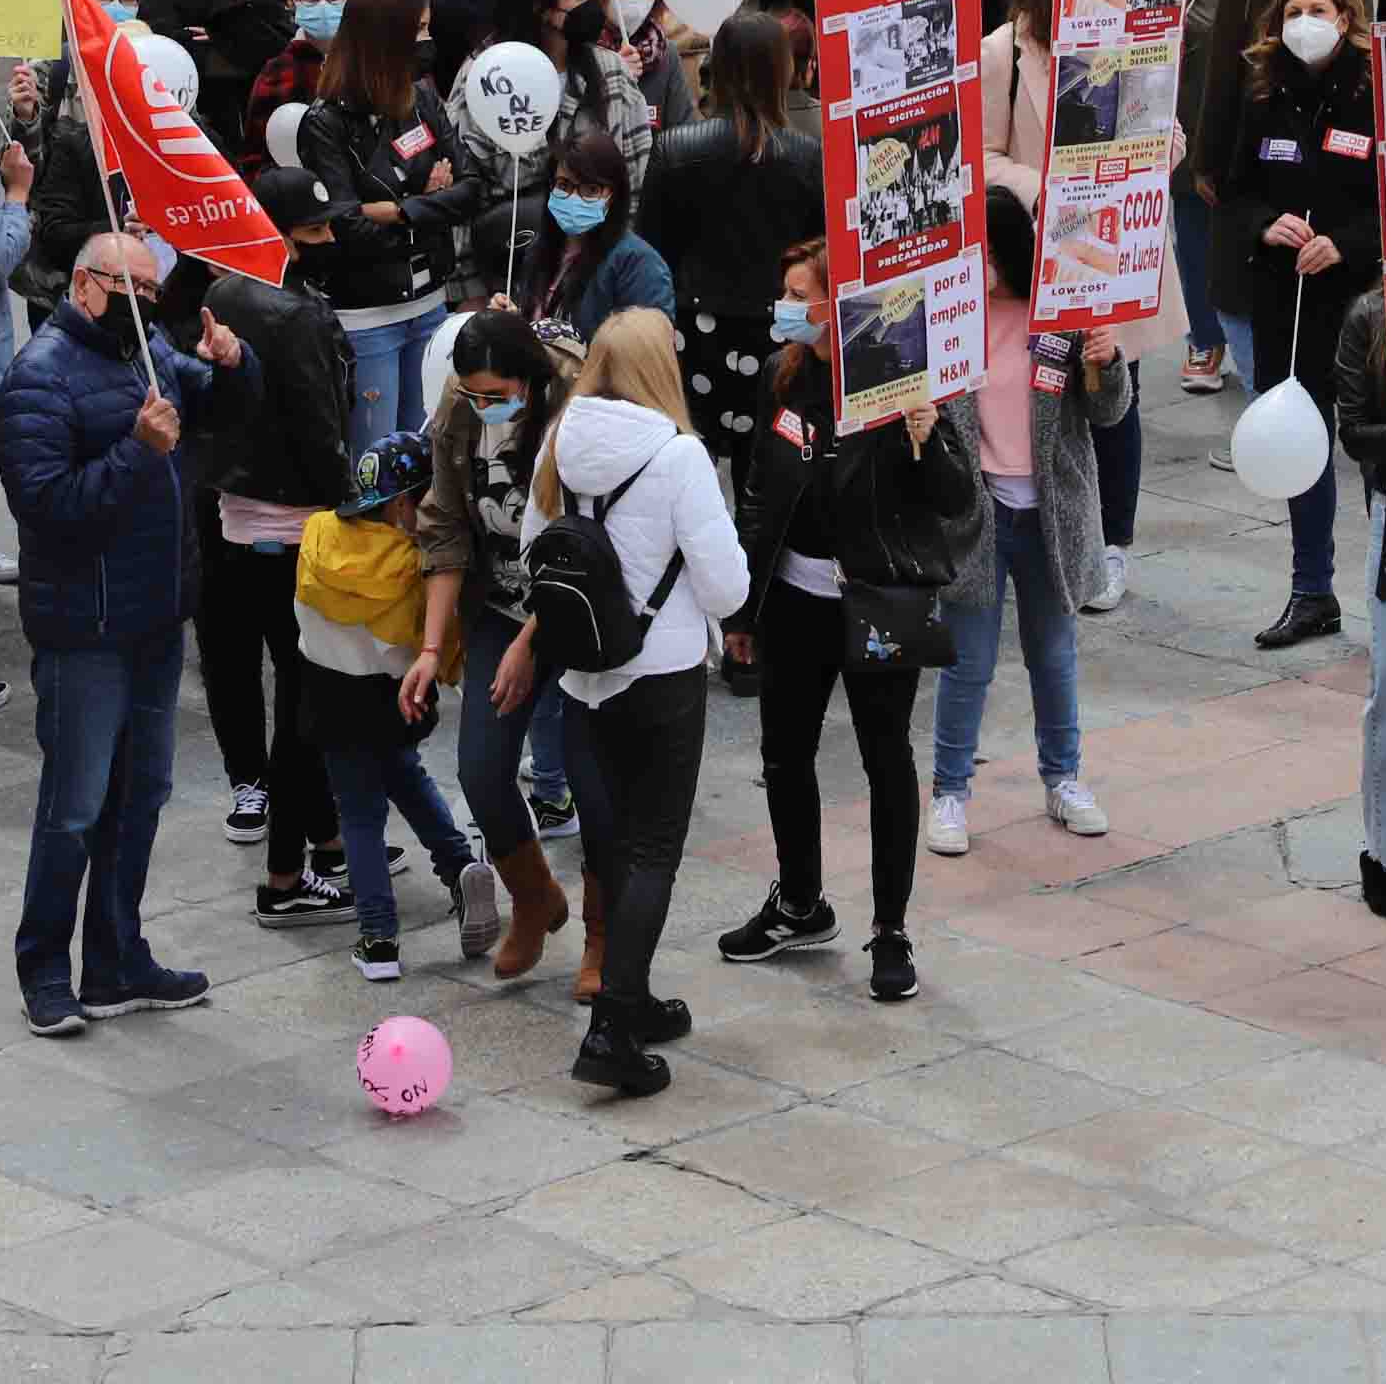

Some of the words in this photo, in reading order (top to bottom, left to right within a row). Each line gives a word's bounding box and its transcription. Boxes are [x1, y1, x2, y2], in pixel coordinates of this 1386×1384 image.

[1095, 18, 1118, 27] COST
[1130, 55, 1168, 66] DERECHOS
[480, 65, 514, 96] NO
[509, 94, 535, 115] AL
[863, 86, 950, 119] TRANSFORMACIÓN
[498, 116, 544, 135] ERE
[888, 107, 926, 124] DIGITAL
[1123, 189, 1163, 232] CCOO
[878, 239, 949, 268] PRECARIEDAD
[898, 240, 913, 252] NO
[915, 235, 928, 248] ES
[1118, 252, 1131, 276] en
[1132, 240, 1159, 273] Lucha
[934, 273, 955, 295] por
[959, 265, 971, 284] el
[1051, 286, 1076, 296] LOW
[1080, 283, 1108, 293] COST
[930, 301, 977, 327] empleo
[944, 335, 960, 352] en
[939, 359, 970, 385] H&M
